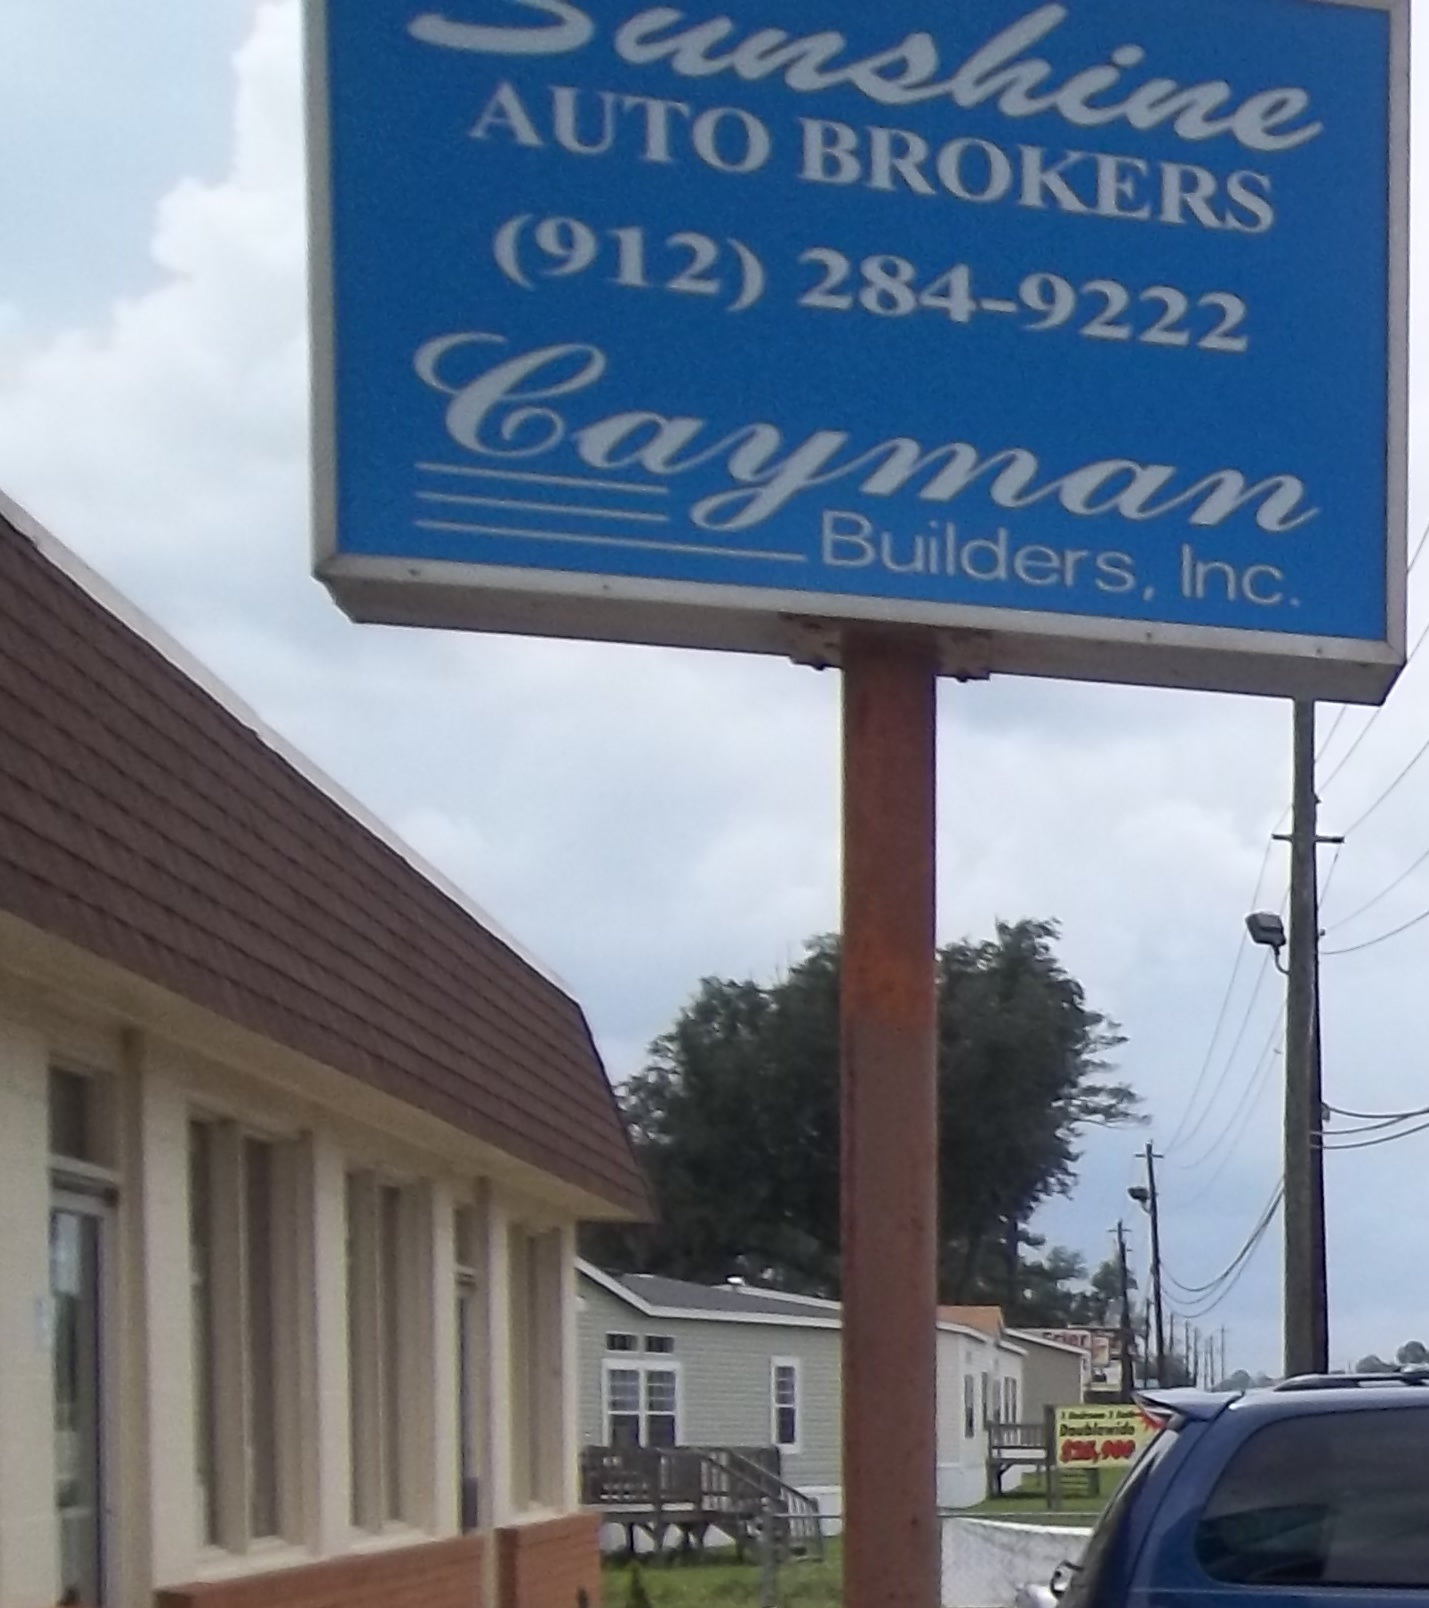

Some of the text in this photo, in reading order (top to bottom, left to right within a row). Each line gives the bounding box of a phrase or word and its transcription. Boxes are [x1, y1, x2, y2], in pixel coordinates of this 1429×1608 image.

[406, 0, 1324, 152] Sunshine
[470, 79, 1277, 235] AUTO BROKERS
[493, 211, 1252, 353] (912) 284-9222
[413, 332, 1321, 532] Cayman
[820, 509, 1303, 607] Builders, Inc.
